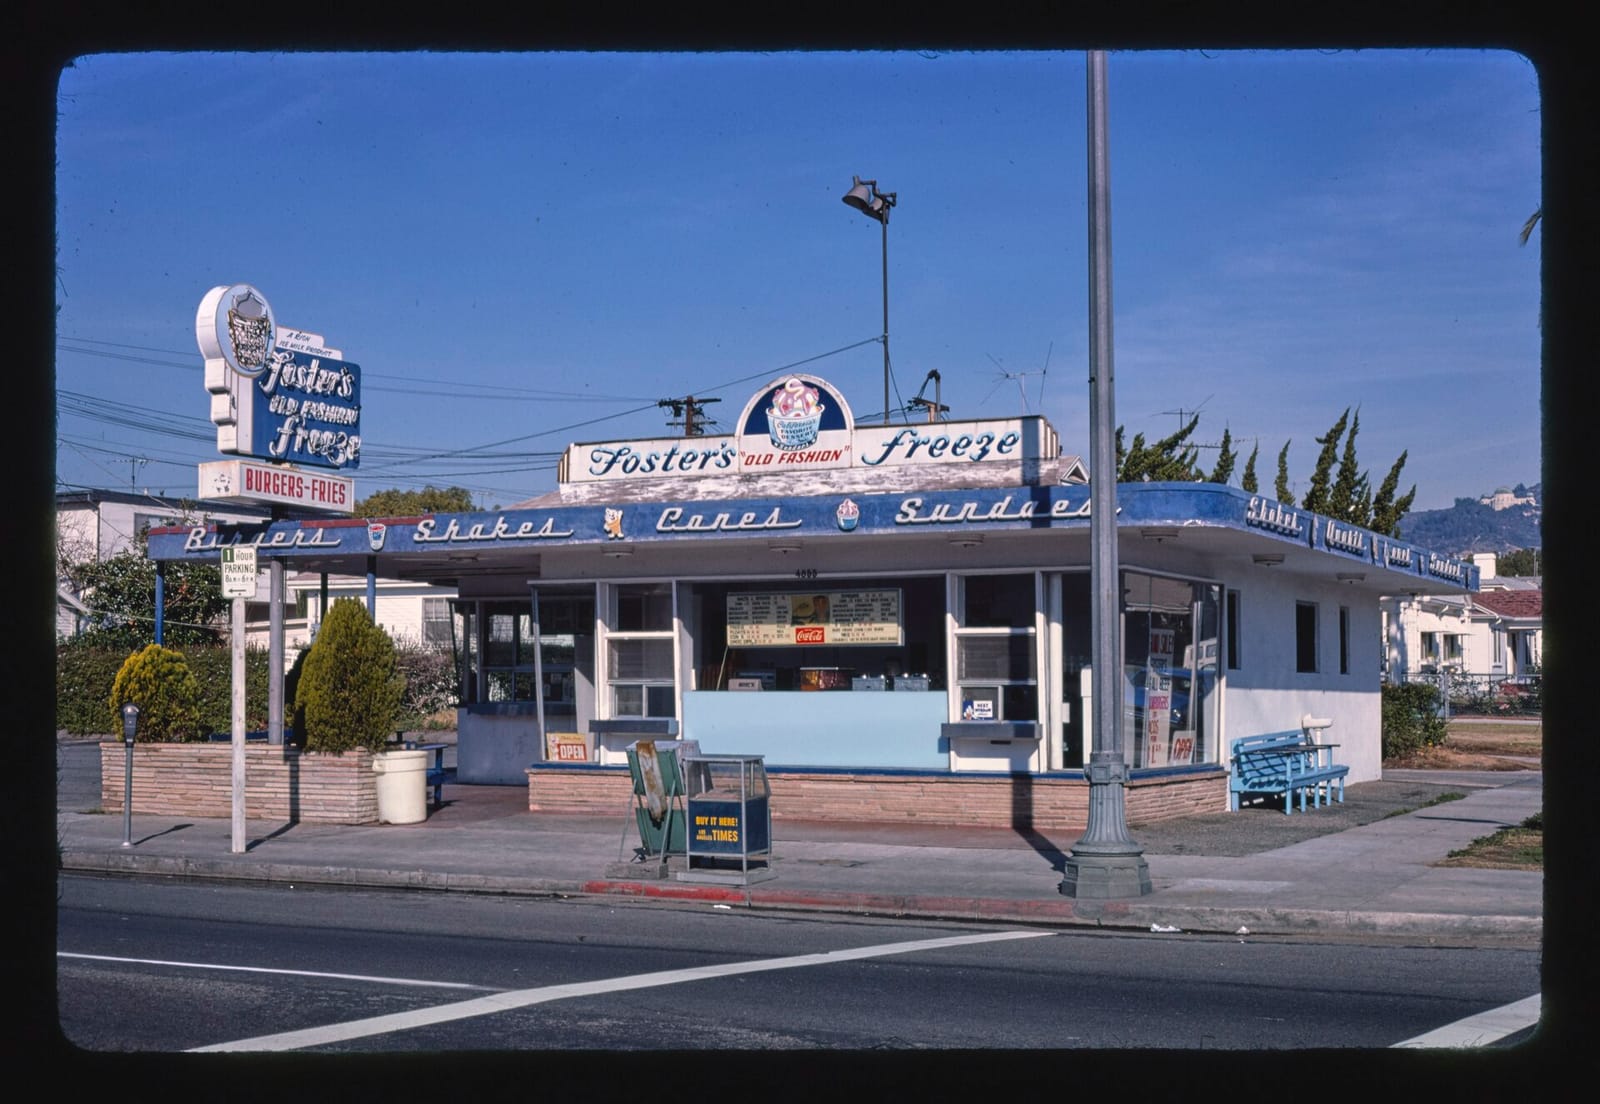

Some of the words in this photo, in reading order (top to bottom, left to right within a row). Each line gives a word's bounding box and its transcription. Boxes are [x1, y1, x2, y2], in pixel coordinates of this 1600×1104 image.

[290, 341, 304, 350] MILK
[258, 350, 355, 398] Foster's
[589, 441, 737, 478] Foster's
[412, 516, 575, 543] Shakes
[654, 506, 803, 533] Cones
[235, 551, 254, 561] HOUR
[224, 563, 254, 574] PARKING
[559, 744, 585, 760] OPEN
[695, 815, 709, 826] BUY
[710, 816, 717, 826] IT
[718, 816, 739, 827] HERE!
[712, 829, 739, 843] TIMES
